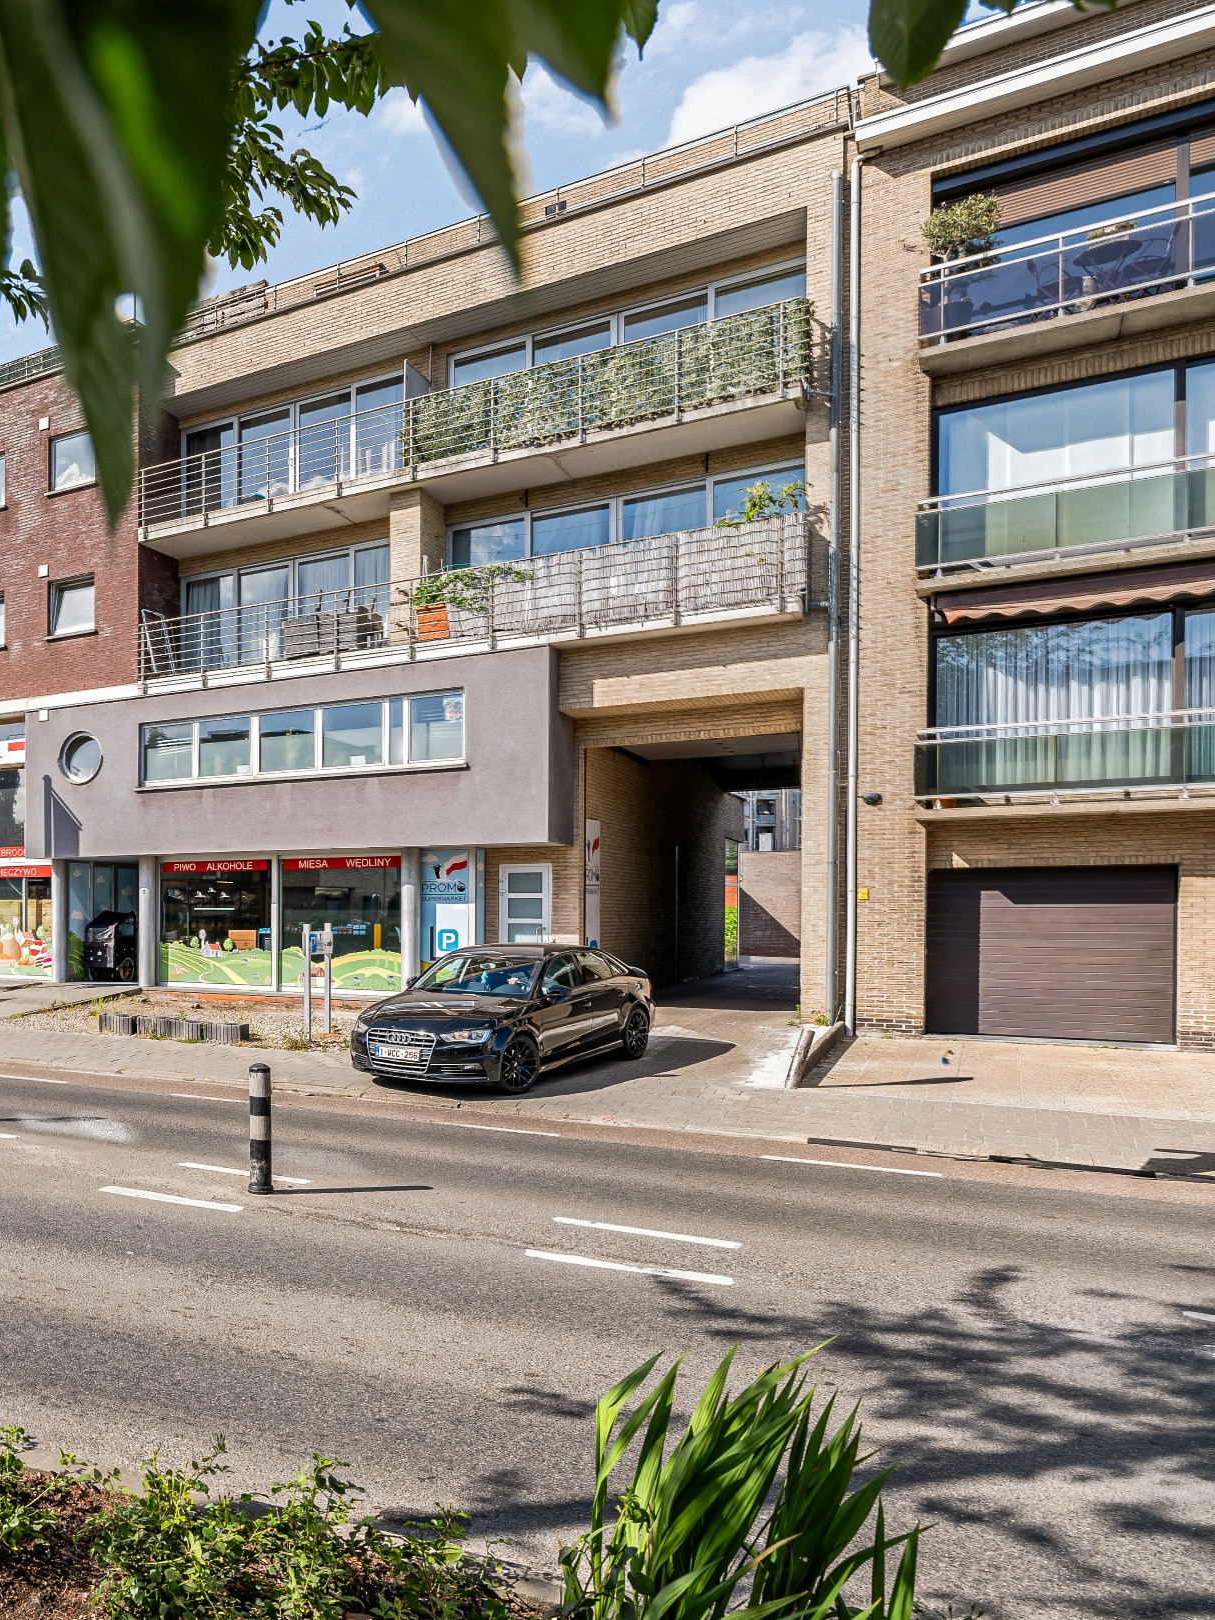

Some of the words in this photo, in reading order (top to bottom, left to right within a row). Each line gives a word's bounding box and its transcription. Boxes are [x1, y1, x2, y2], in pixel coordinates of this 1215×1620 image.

[0, 848, 26, 857] BROO
[173, 863, 197, 871] PIWO
[206, 862, 253, 871] ALKOHOLE
[421, 882, 466, 893] PROMO
[442, 932, 456, 950] P
